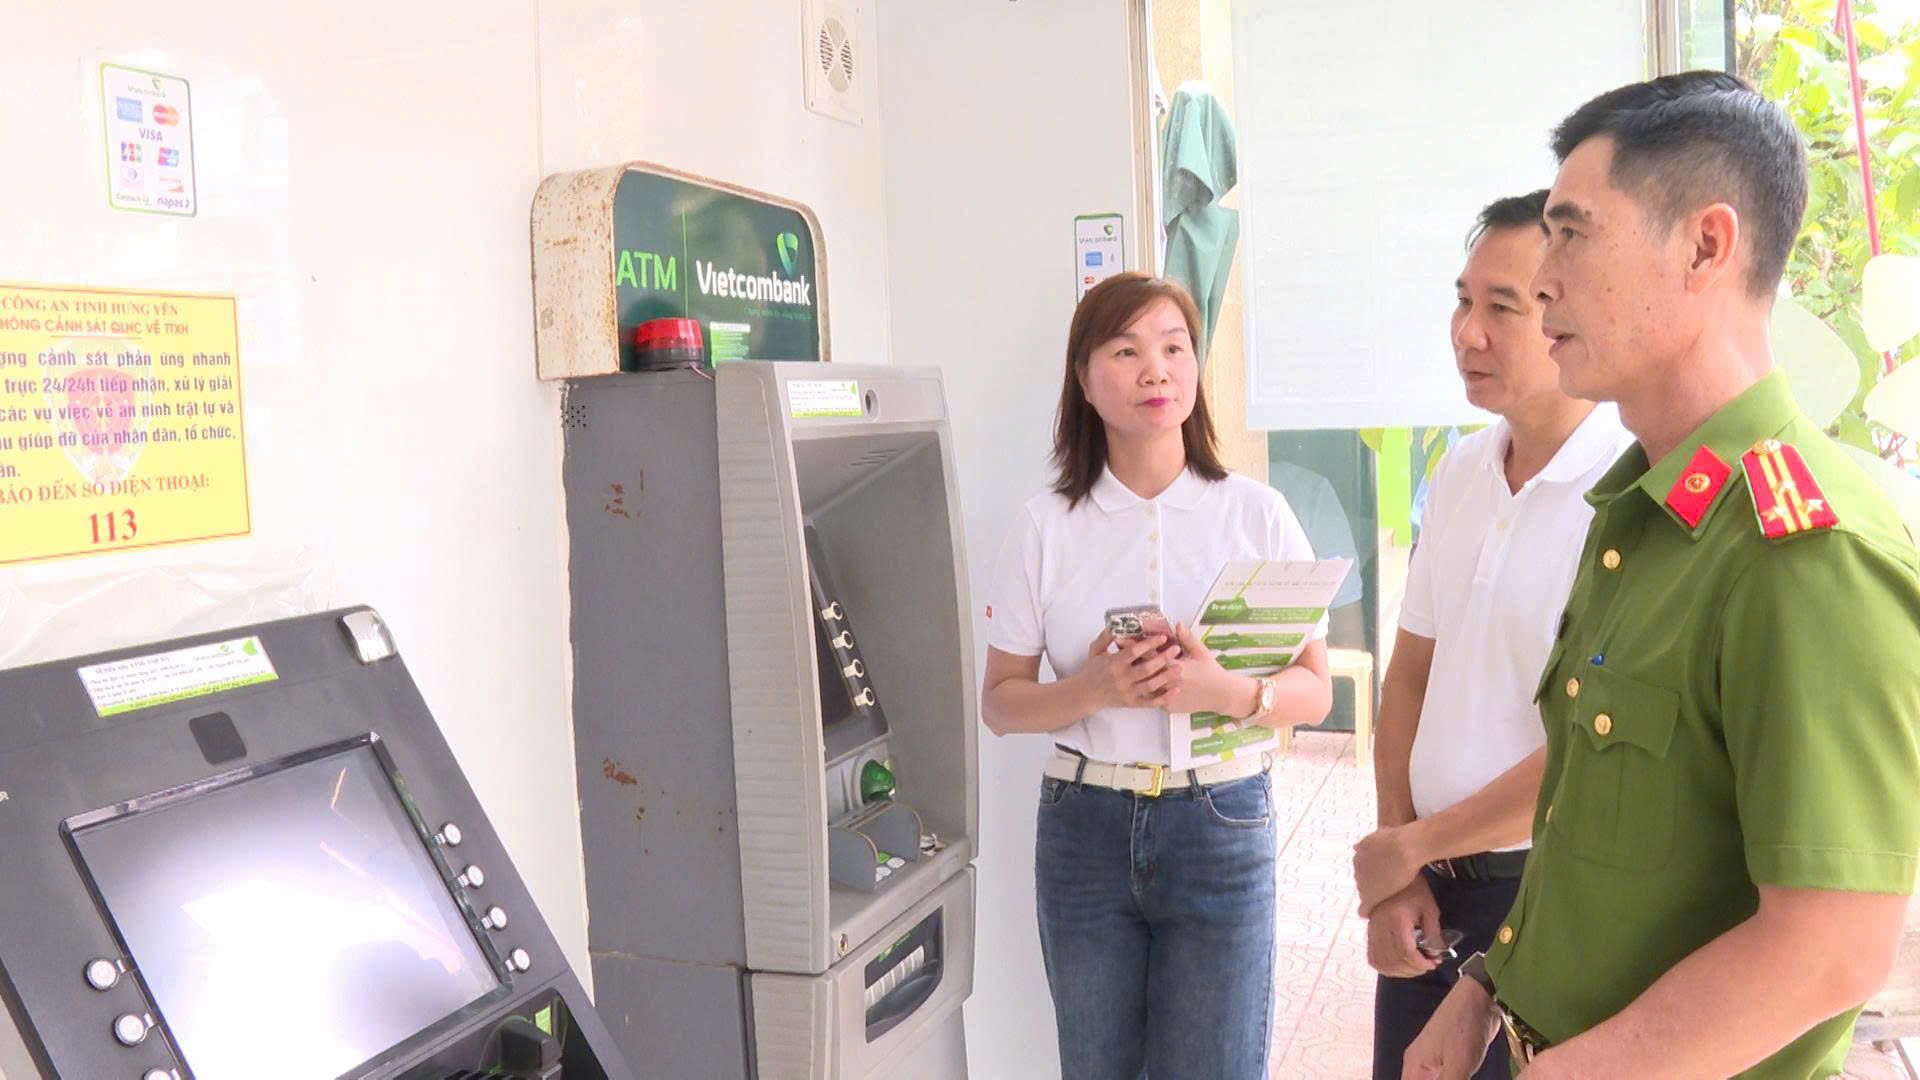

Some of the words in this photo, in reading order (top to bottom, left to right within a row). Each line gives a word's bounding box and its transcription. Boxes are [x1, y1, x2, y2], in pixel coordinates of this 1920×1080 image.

[138, 128, 163, 142] VISA
[616, 250, 677, 291] ATM
[696, 260, 811, 306] Vietcombank
[192, 352, 231, 366] nhanh
[42, 377, 95, 393] 24/24h
[119, 404, 136, 418] an
[142, 402, 171, 417] ninh
[88, 508, 138, 544] 113
